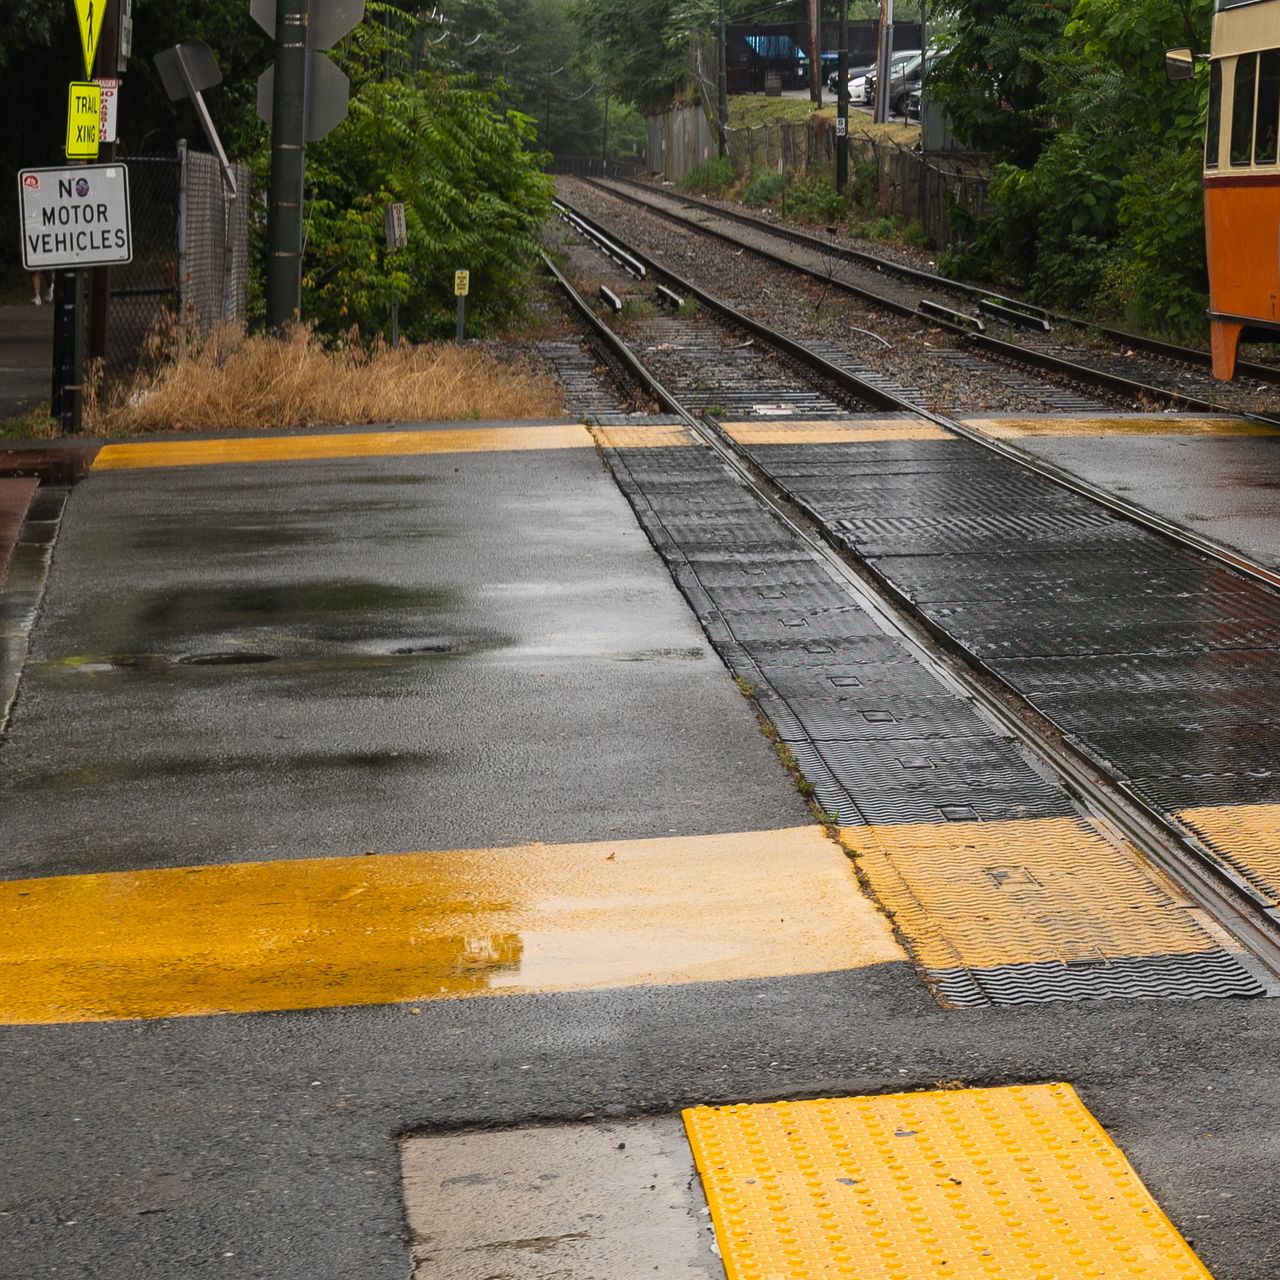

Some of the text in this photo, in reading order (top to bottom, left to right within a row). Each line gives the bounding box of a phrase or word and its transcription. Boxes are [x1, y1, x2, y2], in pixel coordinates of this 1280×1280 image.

[75, 96, 97, 114] TRAIL
[76, 125, 96, 143] XING
[42, 203, 109, 227] MOTOR
[28, 228, 126, 254] VEHICLES
